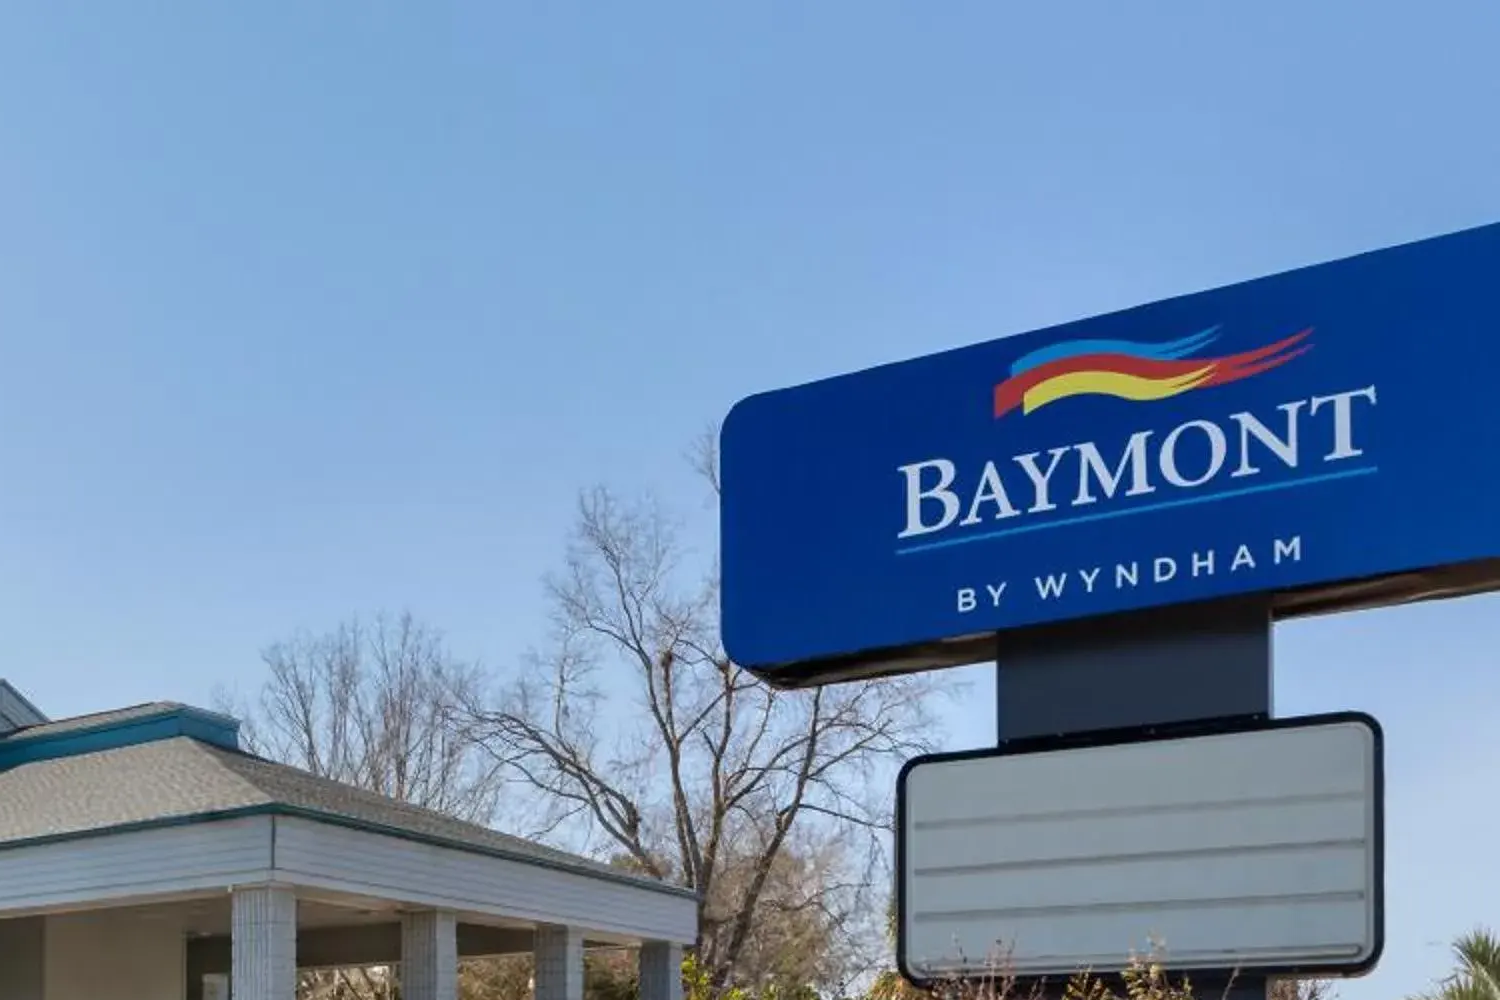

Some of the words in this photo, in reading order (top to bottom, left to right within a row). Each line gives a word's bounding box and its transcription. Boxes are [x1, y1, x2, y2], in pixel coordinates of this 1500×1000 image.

[897, 386, 1377, 539] BAYMONT
[957, 581, 1008, 612] BY
[1035, 535, 1303, 600] WYNDHAM
